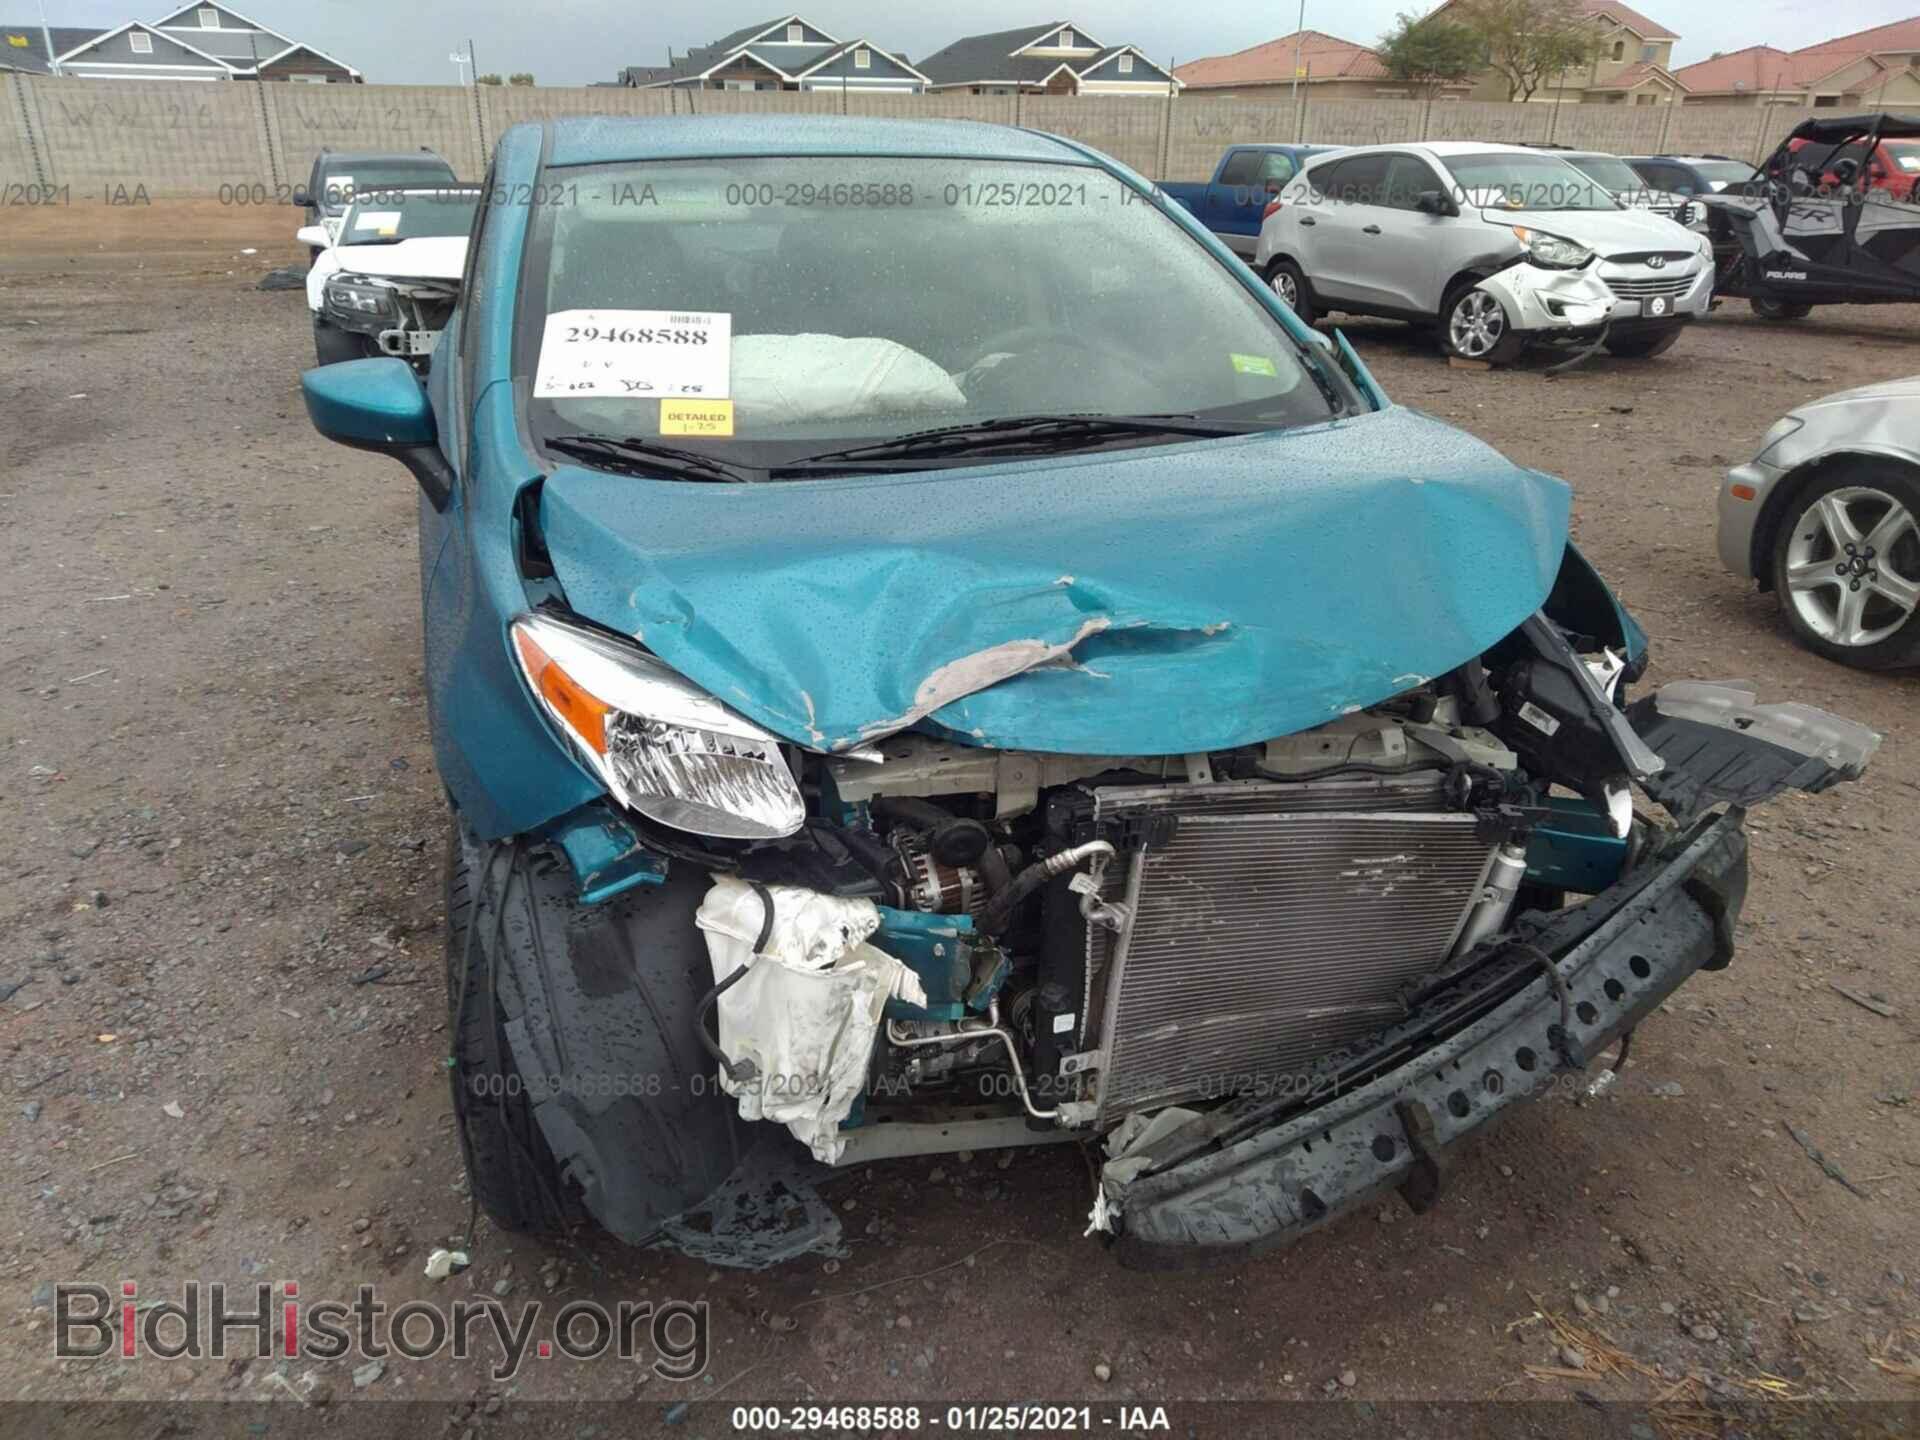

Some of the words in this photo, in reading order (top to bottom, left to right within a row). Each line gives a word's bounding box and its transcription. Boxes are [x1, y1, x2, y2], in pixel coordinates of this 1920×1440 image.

[1766, 271, 1807, 280] POLARIS
[566, 327, 708, 345] 29468588
[667, 412, 727, 422] DETAILED
